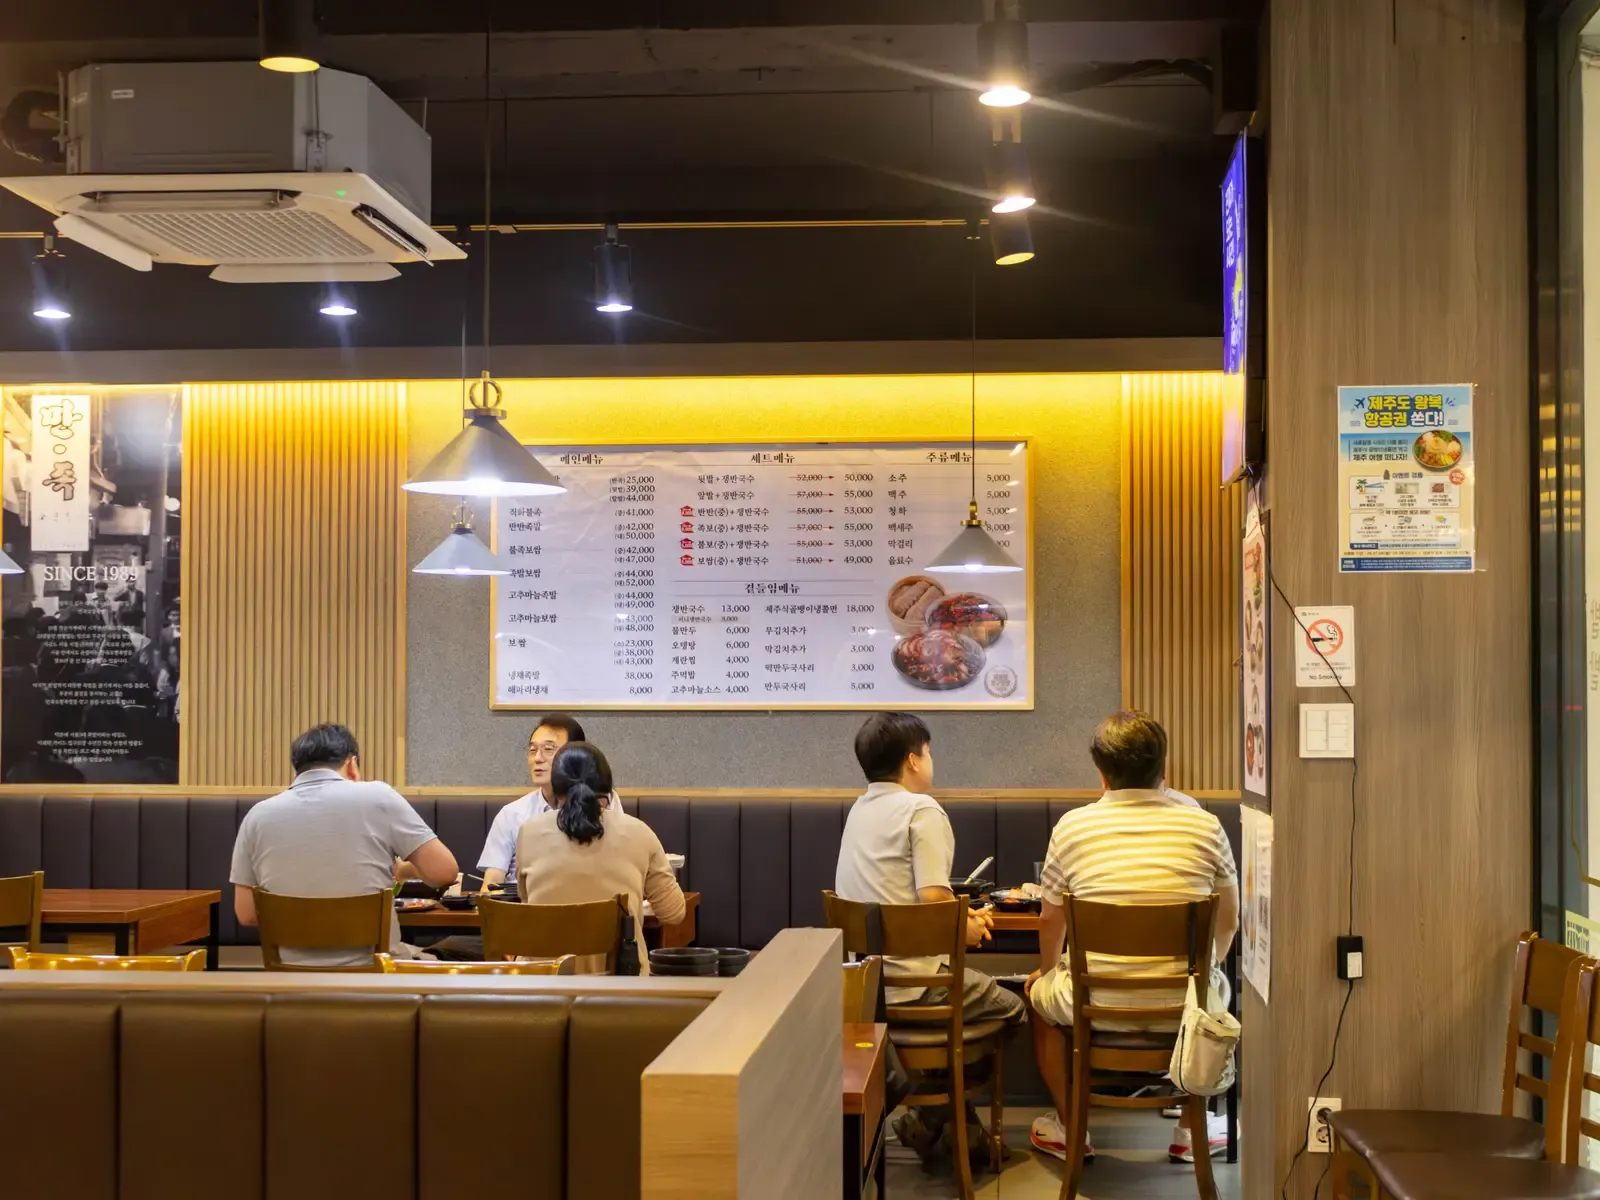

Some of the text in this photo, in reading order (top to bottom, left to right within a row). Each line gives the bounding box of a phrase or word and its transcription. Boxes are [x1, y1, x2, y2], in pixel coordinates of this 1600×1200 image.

[1368, 394, 1443, 410] 제주도 왕복
[1364, 410, 1444, 428] 항공권 쏜다!
[560, 454, 604, 464] 메인메뉴
[751, 452, 795, 464] 세트메뉴
[926, 452, 972, 462] 주류메뉴
[722, 474, 754, 484] 쟁반국수
[844, 474, 873, 482] 50,000
[986, 474, 1010, 482] 5,000
[722, 490, 754, 500] 쟁반국수
[844, 490, 873, 499] 55,000
[986, 490, 1010, 499] 5,000
[698, 507, 728, 518] 반반(중)
[736, 507, 769, 518] 쟁반국수
[844, 506, 873, 515] 53,000
[509, 522, 542, 531] 반반족발
[736, 524, 769, 534] 쟁반국수
[844, 523, 873, 532] 55,000
[888, 523, 1010, 532] 백세주 8,000
[736, 540, 769, 550] 쟁반국수
[844, 540, 873, 548] 53,000
[888, 540, 913, 548] 막걸리
[509, 546, 542, 554] 불족보쌈
[698, 556, 728, 566] 보쌈(중)
[736, 556, 769, 566] 쟁반국수
[844, 556, 873, 564] 49,000
[888, 556, 913, 565] 음료수
[44, 566, 139, 582] SINCE 1989
[745, 582, 800, 594] 곁들임메뉴
[508, 590, 557, 600] 고추마늘족발
[672, 604, 750, 614] 쟁반국수 13,000
[846, 604, 875, 614] 18,000
[508, 614, 557, 623] 고추마늘보쌈
[672, 626, 750, 636] 물만두 6,000
[764, 626, 806, 636] 무김치추가
[726, 641, 750, 650] 6,000
[764, 644, 874, 654] 막김치추가 3,000
[672, 656, 750, 665] 계란찜 4,000
[764, 664, 874, 673] 떡만두국사리 3,000
[508, 670, 653, 680] 냉채족발 38,000
[671, 670, 750, 680] 주먹밥 4,000
[508, 685, 652, 695] 해파리냉채 8,000
[671, 685, 750, 694] 고추마늘소스 4,000
[764, 682, 874, 692] 만두국사리 5,000
